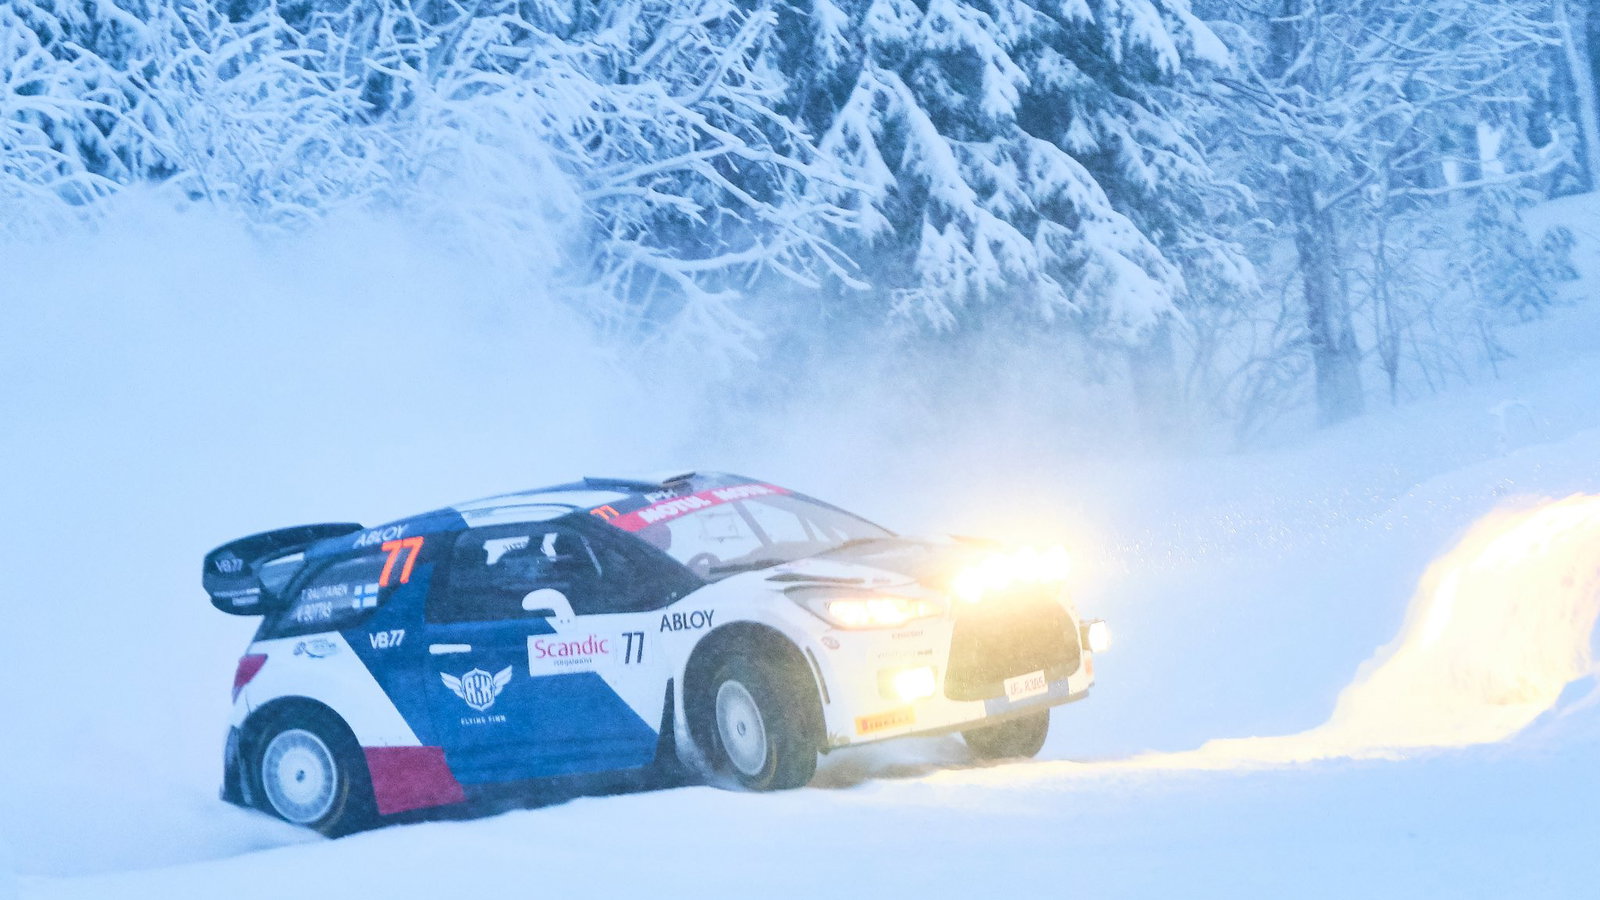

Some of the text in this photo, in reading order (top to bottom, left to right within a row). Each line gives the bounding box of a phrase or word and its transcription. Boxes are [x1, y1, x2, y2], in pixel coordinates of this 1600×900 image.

[589, 504, 620, 520] 77
[638, 496, 712, 523] MOTUL
[353, 524, 410, 549] ABLOY
[378, 535, 424, 587] 77
[659, 609, 714, 633] ABLOY
[368, 629, 406, 649] VB77
[534, 633, 609, 659] Scandic
[621, 631, 644, 665] 77
